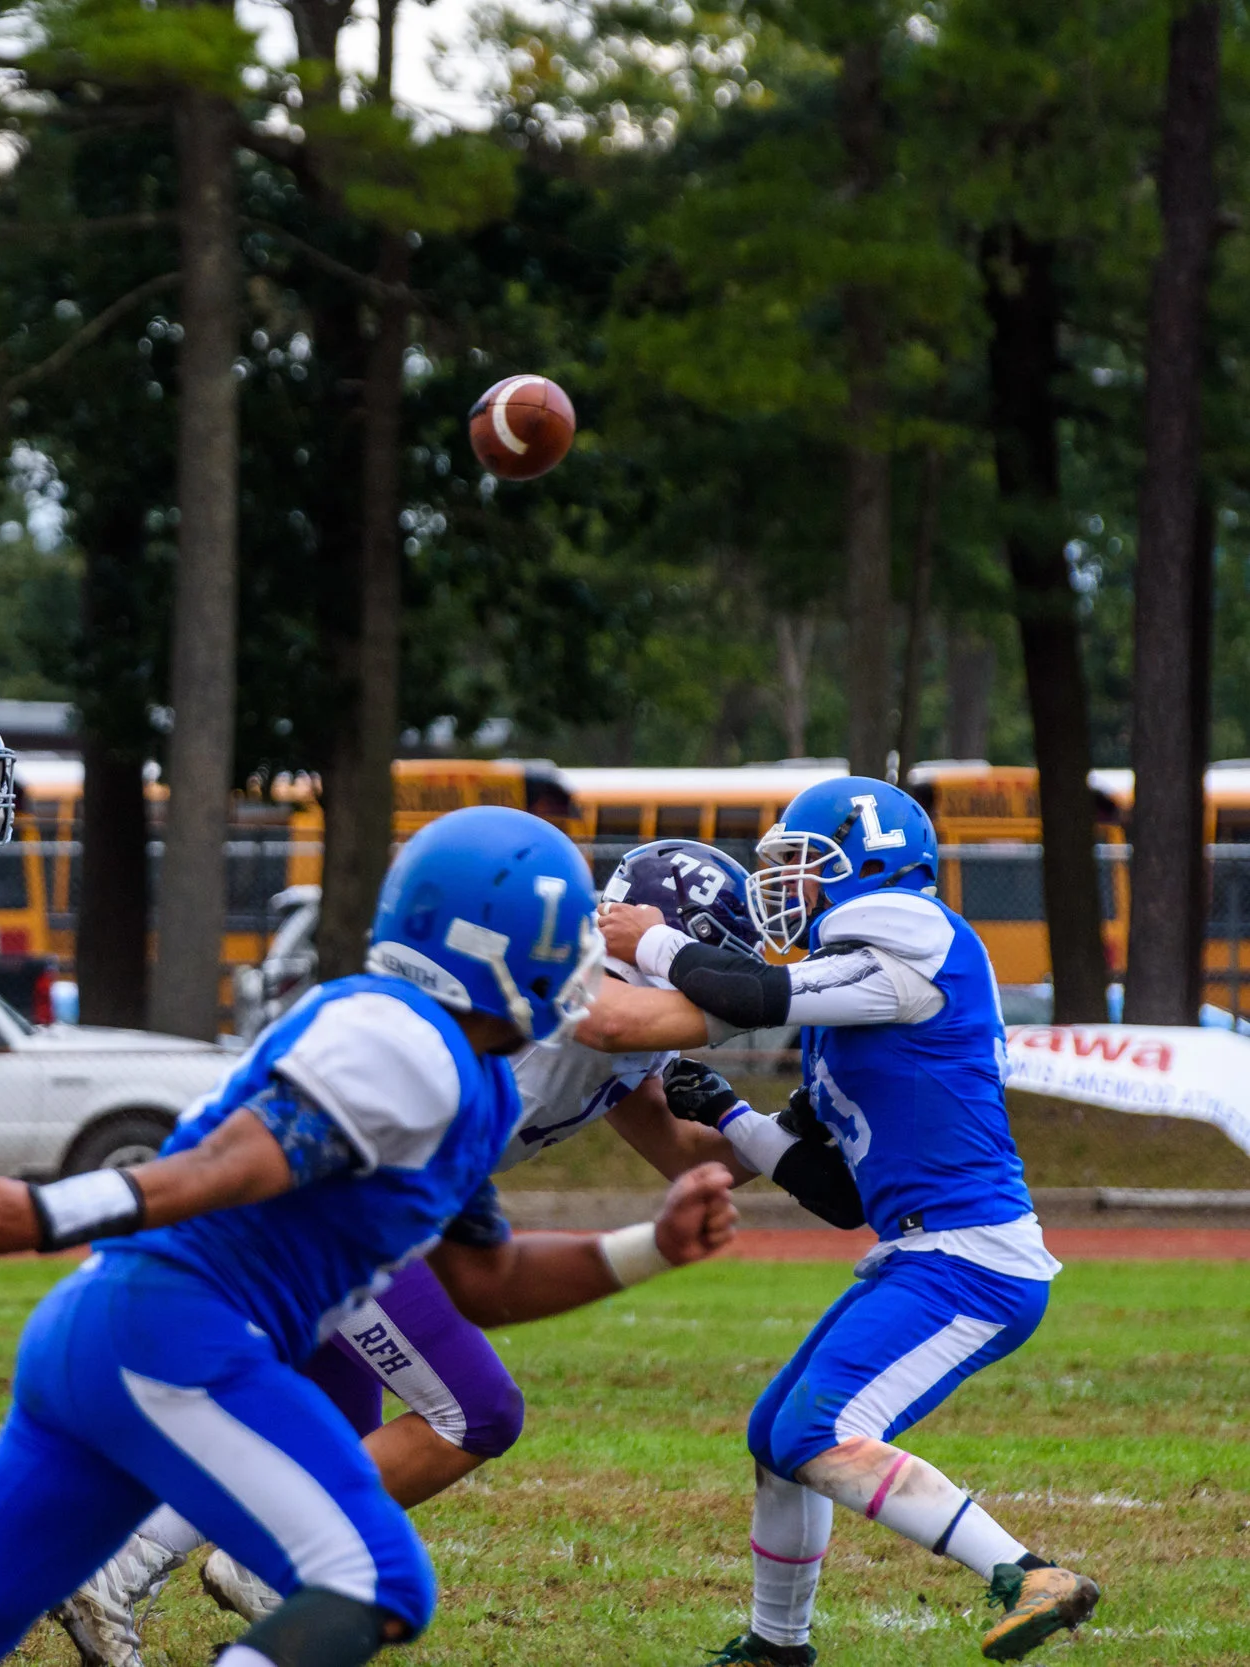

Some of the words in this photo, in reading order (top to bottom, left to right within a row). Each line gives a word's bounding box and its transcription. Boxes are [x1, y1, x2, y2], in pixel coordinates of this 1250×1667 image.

[851, 794, 907, 852] L
[661, 852, 727, 906] 73
[530, 874, 572, 963] L
[1006, 1024, 1174, 1072] awa
[352, 1321, 414, 1376] RFH
